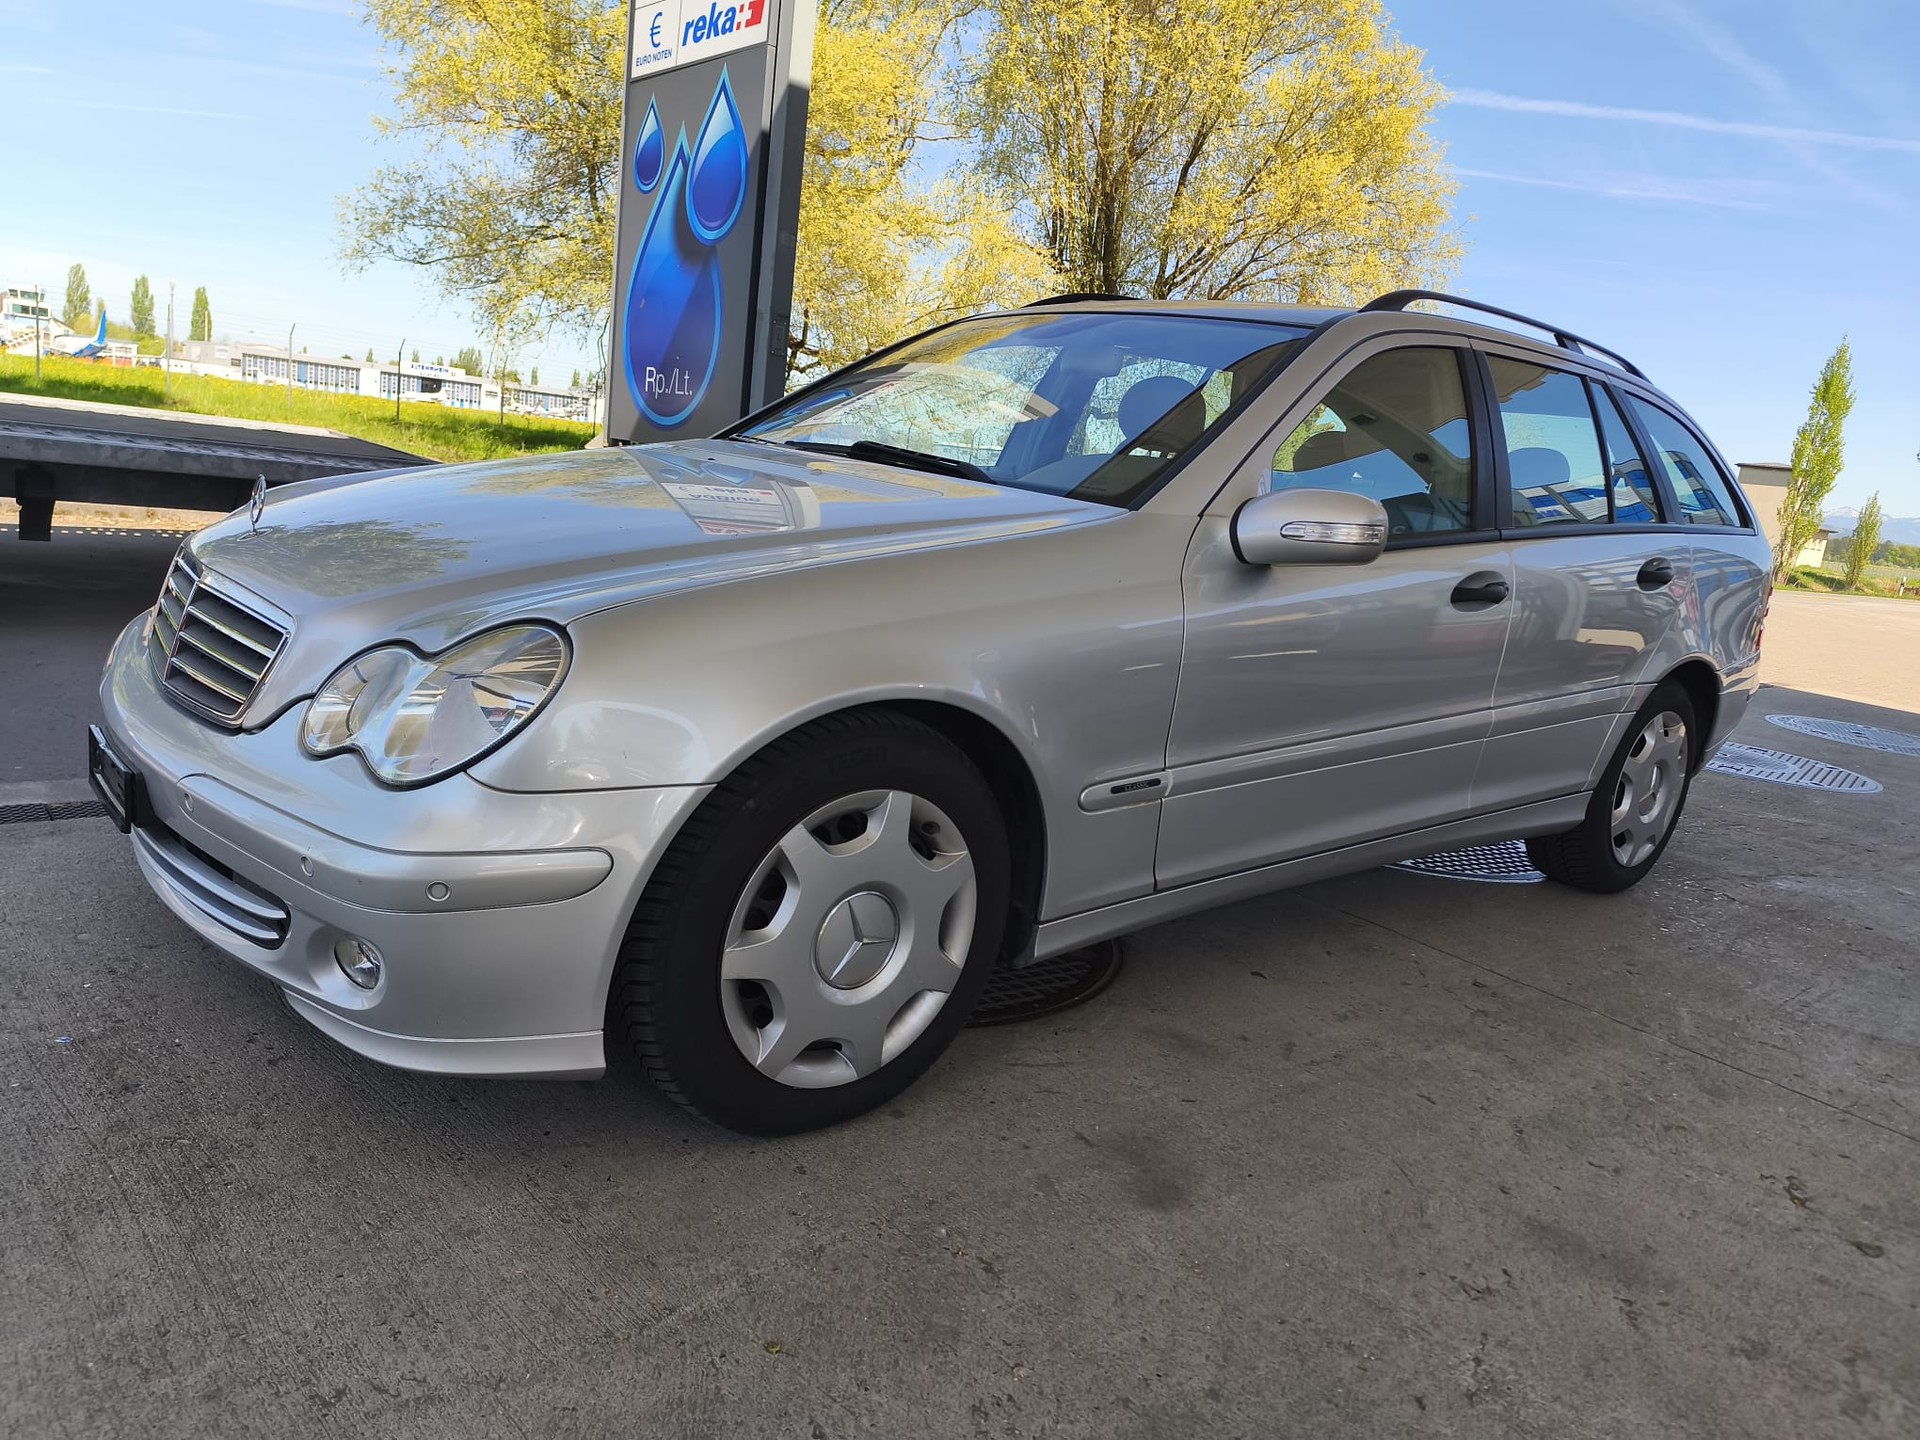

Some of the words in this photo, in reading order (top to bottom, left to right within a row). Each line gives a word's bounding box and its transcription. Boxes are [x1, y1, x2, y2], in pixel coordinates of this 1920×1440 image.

[636, 54, 651, 66] EURO
[652, 48, 672, 61] NOTEN
[645, 366, 693, 399] Rp./Lt.
